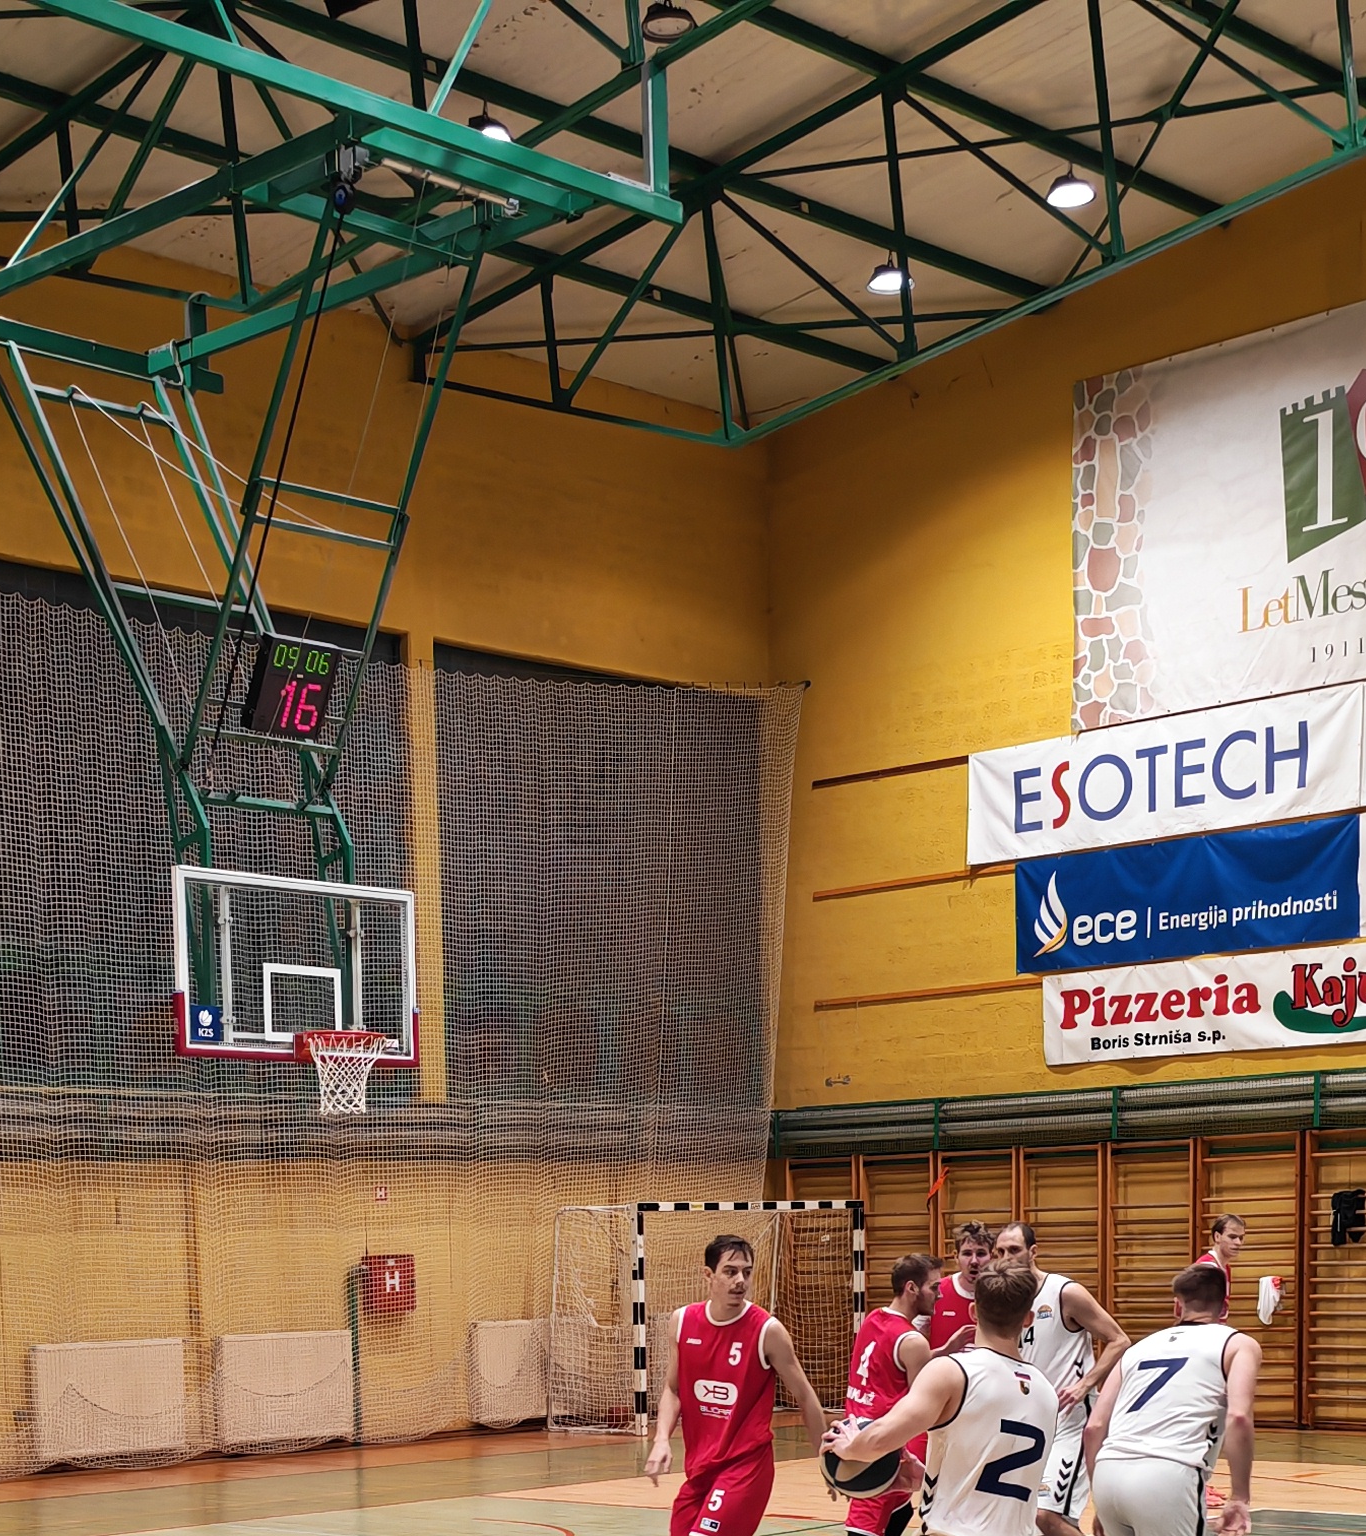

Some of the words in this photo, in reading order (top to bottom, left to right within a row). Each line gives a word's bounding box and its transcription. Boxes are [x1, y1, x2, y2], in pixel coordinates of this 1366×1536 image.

[274, 644, 300, 669] 09
[305, 650, 331, 675] 06
[281, 681, 322, 731] 16
[1013, 720, 1308, 834] ESOTECH
[1072, 908, 1137, 947] ece
[1159, 905, 1228, 932] Energija
[1233, 890, 1337, 925] prihodnosti
[1060, 975, 1261, 1029] Pizzeria
[1090, 1033, 1130, 1051] Boris
[1133, 1029, 1192, 1047] Strniša
[1197, 1030, 1226, 1045] s.p.
[385, 1271, 400, 1292] H
[728, 1342, 742, 1366] 5
[856, 1341, 876, 1386] 4
[1126, 1357, 1189, 1413] 7
[976, 1419, 1046, 1502] 2
[708, 1489, 725, 1511] 5
